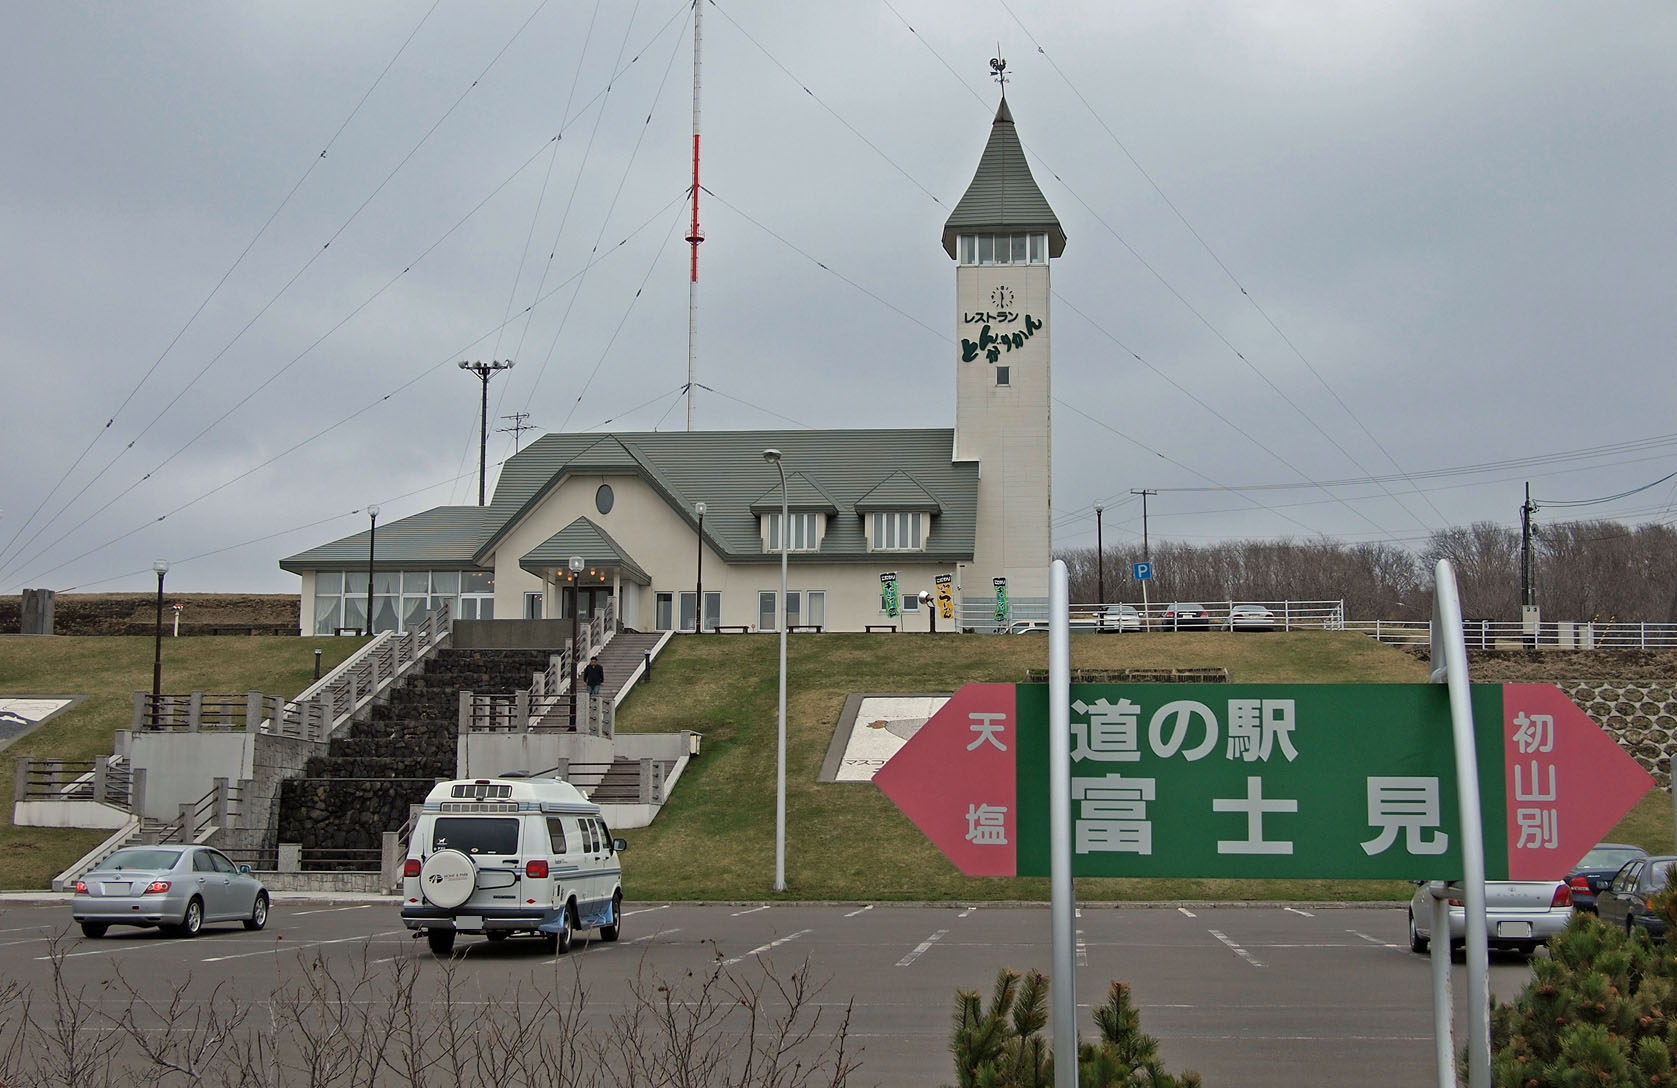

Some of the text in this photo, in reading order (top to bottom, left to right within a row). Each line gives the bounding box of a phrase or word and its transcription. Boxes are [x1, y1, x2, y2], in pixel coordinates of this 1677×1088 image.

[964, 312, 1019, 323] レストラン
[1138, 564, 1148, 578] P
[1070, 698, 1299, 763] 道の駅
[965, 712, 1008, 845] 天塩
[1071, 773, 1449, 856] 富士見
[1512, 711, 1559, 850] 初山別
